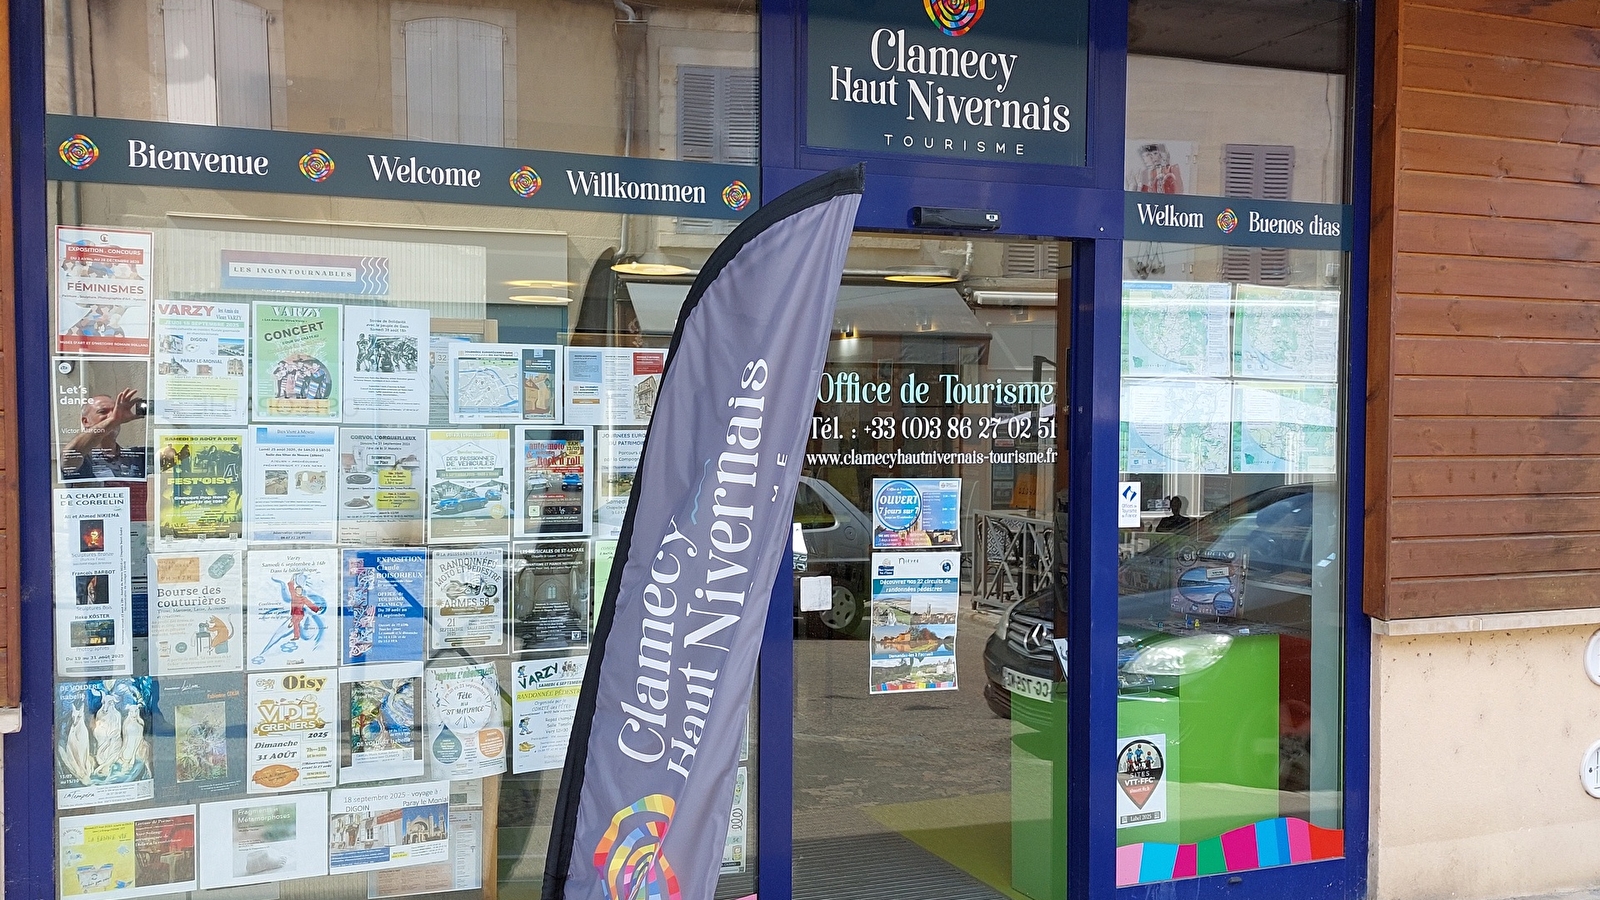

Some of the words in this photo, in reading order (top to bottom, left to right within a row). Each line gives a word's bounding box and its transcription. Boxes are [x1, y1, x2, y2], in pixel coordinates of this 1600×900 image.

[871, 28, 1017, 93] Clamecy
[831, 65, 898, 105] Haut
[906, 79, 1071, 132] Nivernais
[884, 134, 1024, 155] TOURISME
[128, 139, 269, 176] Bienvenue
[367, 153, 481, 188] Welcome
[566, 170, 706, 204] Willkommen
[1137, 203, 1204, 229] Welkom
[1249, 211, 1304, 235] Buenos
[1309, 214, 1341, 237] dias
[257, 267, 352, 277] INCONTOURNABLES
[67, 281, 144, 294] FÉMINISMES
[158, 304, 214, 316] VARZY
[272, 306, 321, 317] VARZY
[264, 321, 324, 341] CONCERT
[60, 385, 87, 394] Let's
[817, 372, 891, 404] Office
[900, 373, 929, 404] de
[939, 374, 1053, 405] Tourisme
[60, 396, 94, 405] dance
[811, 416, 843, 440] Tél.
[864, 417, 896, 439] +33
[901, 416, 941, 440] (0)3
[947, 417, 972, 439] 86
[978, 417, 1002, 439] 27
[1007, 417, 1032, 439] 02
[1038, 417, 1057, 439] 51
[806, 448, 1058, 469] www.clamecyhautnivernais-tourisme.fr
[223, 464, 238, 481] 4
[167, 477, 234, 485] FEST'OISY
[683, 358, 769, 652] Nivernais
[880, 495, 918, 505] OUVERT
[157, 588, 198, 597] Bourse
[202, 586, 221, 595] des
[157, 596, 227, 608] couturières
[445, 598, 477, 607] ARMES
[447, 618, 455, 627] 21
[617, 515, 699, 763] Clamecy
[519, 663, 558, 689] VARZY
[283, 675, 326, 691] Oisy
[517, 690, 553, 700] RANDONNÉE
[258, 703, 318, 723] VIDE
[260, 720, 316, 732] GRENIERS
[666, 662, 719, 779] Haut
[254, 741, 298, 749] Dimanche
[269, 751, 297, 760] AOÛT
[352, 794, 388, 803] septembre
[428, 796, 448, 804] Monial
[238, 814, 290, 823] Métamorphoses
